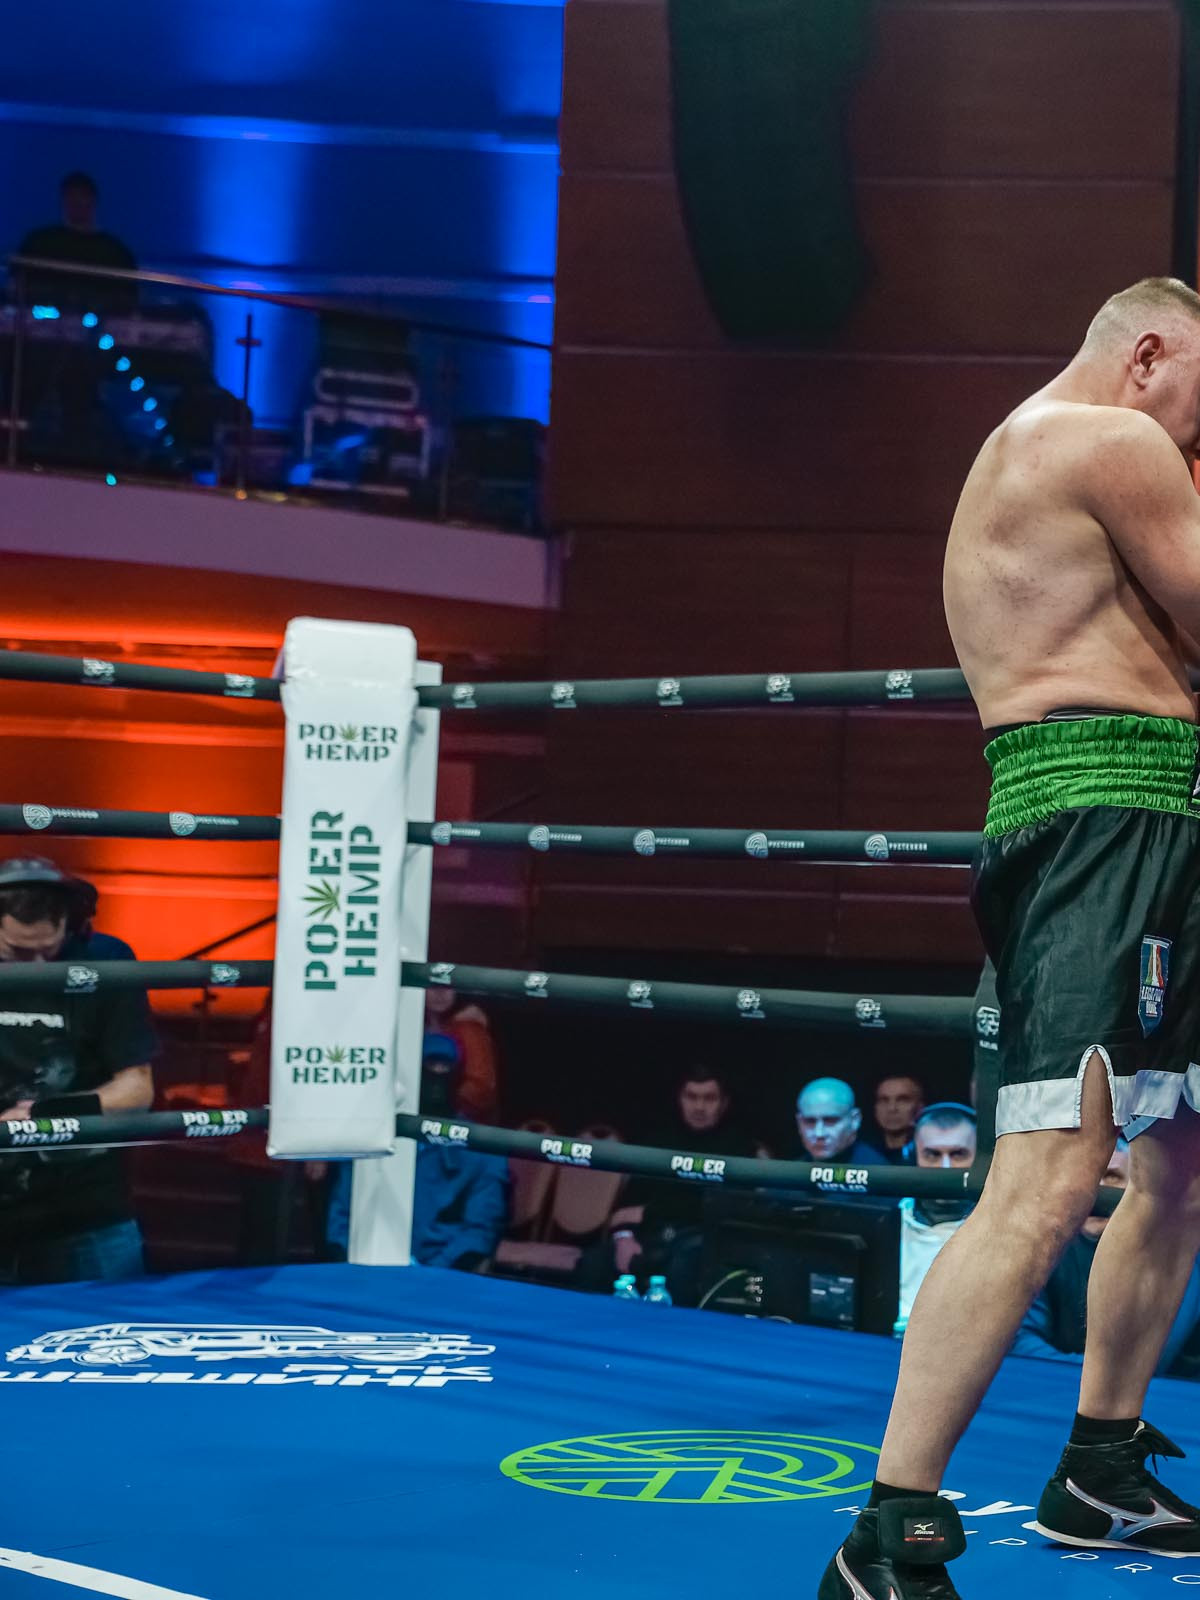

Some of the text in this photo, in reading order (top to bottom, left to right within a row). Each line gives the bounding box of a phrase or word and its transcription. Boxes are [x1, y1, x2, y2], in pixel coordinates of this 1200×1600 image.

[306, 743, 390, 762] HEMP
[344, 825, 381, 976] HEMP
[293, 1067, 378, 1084] HEMP
